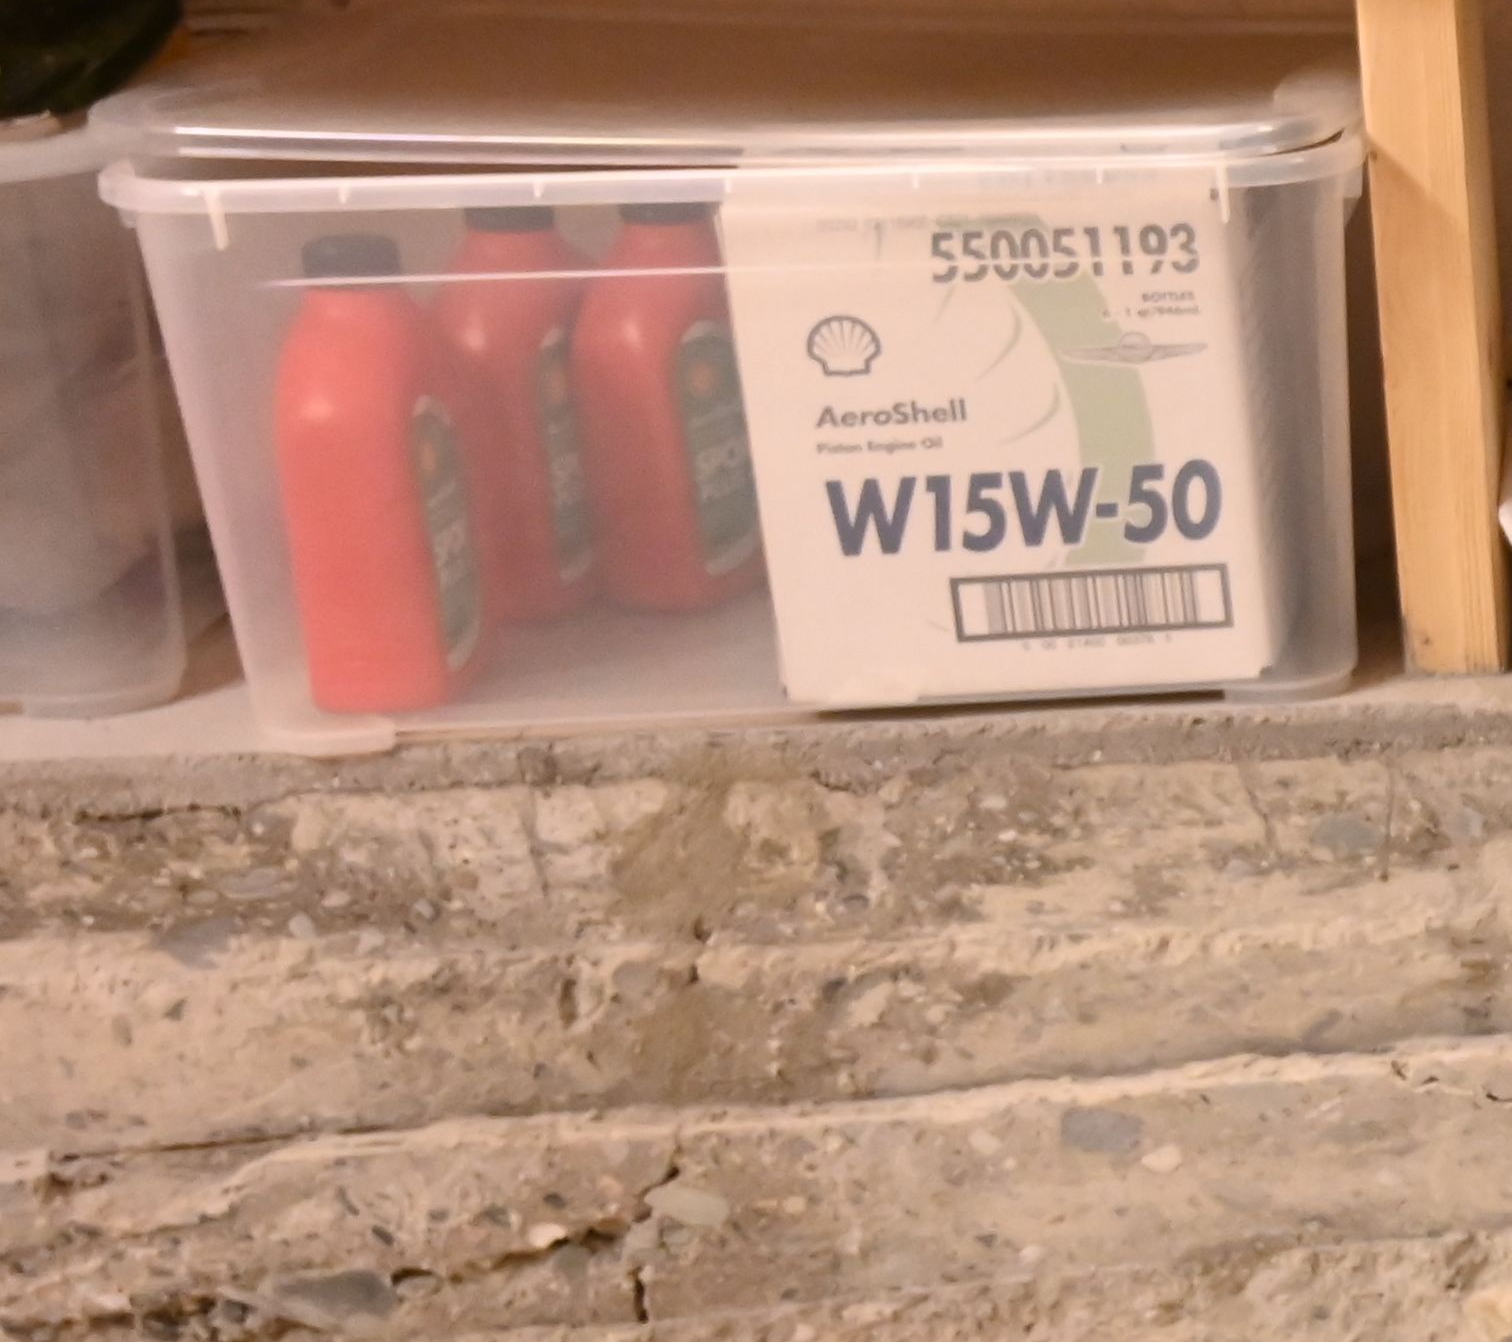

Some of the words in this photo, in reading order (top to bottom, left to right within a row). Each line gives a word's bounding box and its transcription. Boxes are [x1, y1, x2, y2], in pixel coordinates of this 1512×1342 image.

[930, 222, 1200, 283] 550051193
[815, 397, 968, 429] AeroShell
[867, 439, 917, 457] Engine
[921, 435, 943, 450] Oil
[825, 458, 1223, 557] W15W-50
